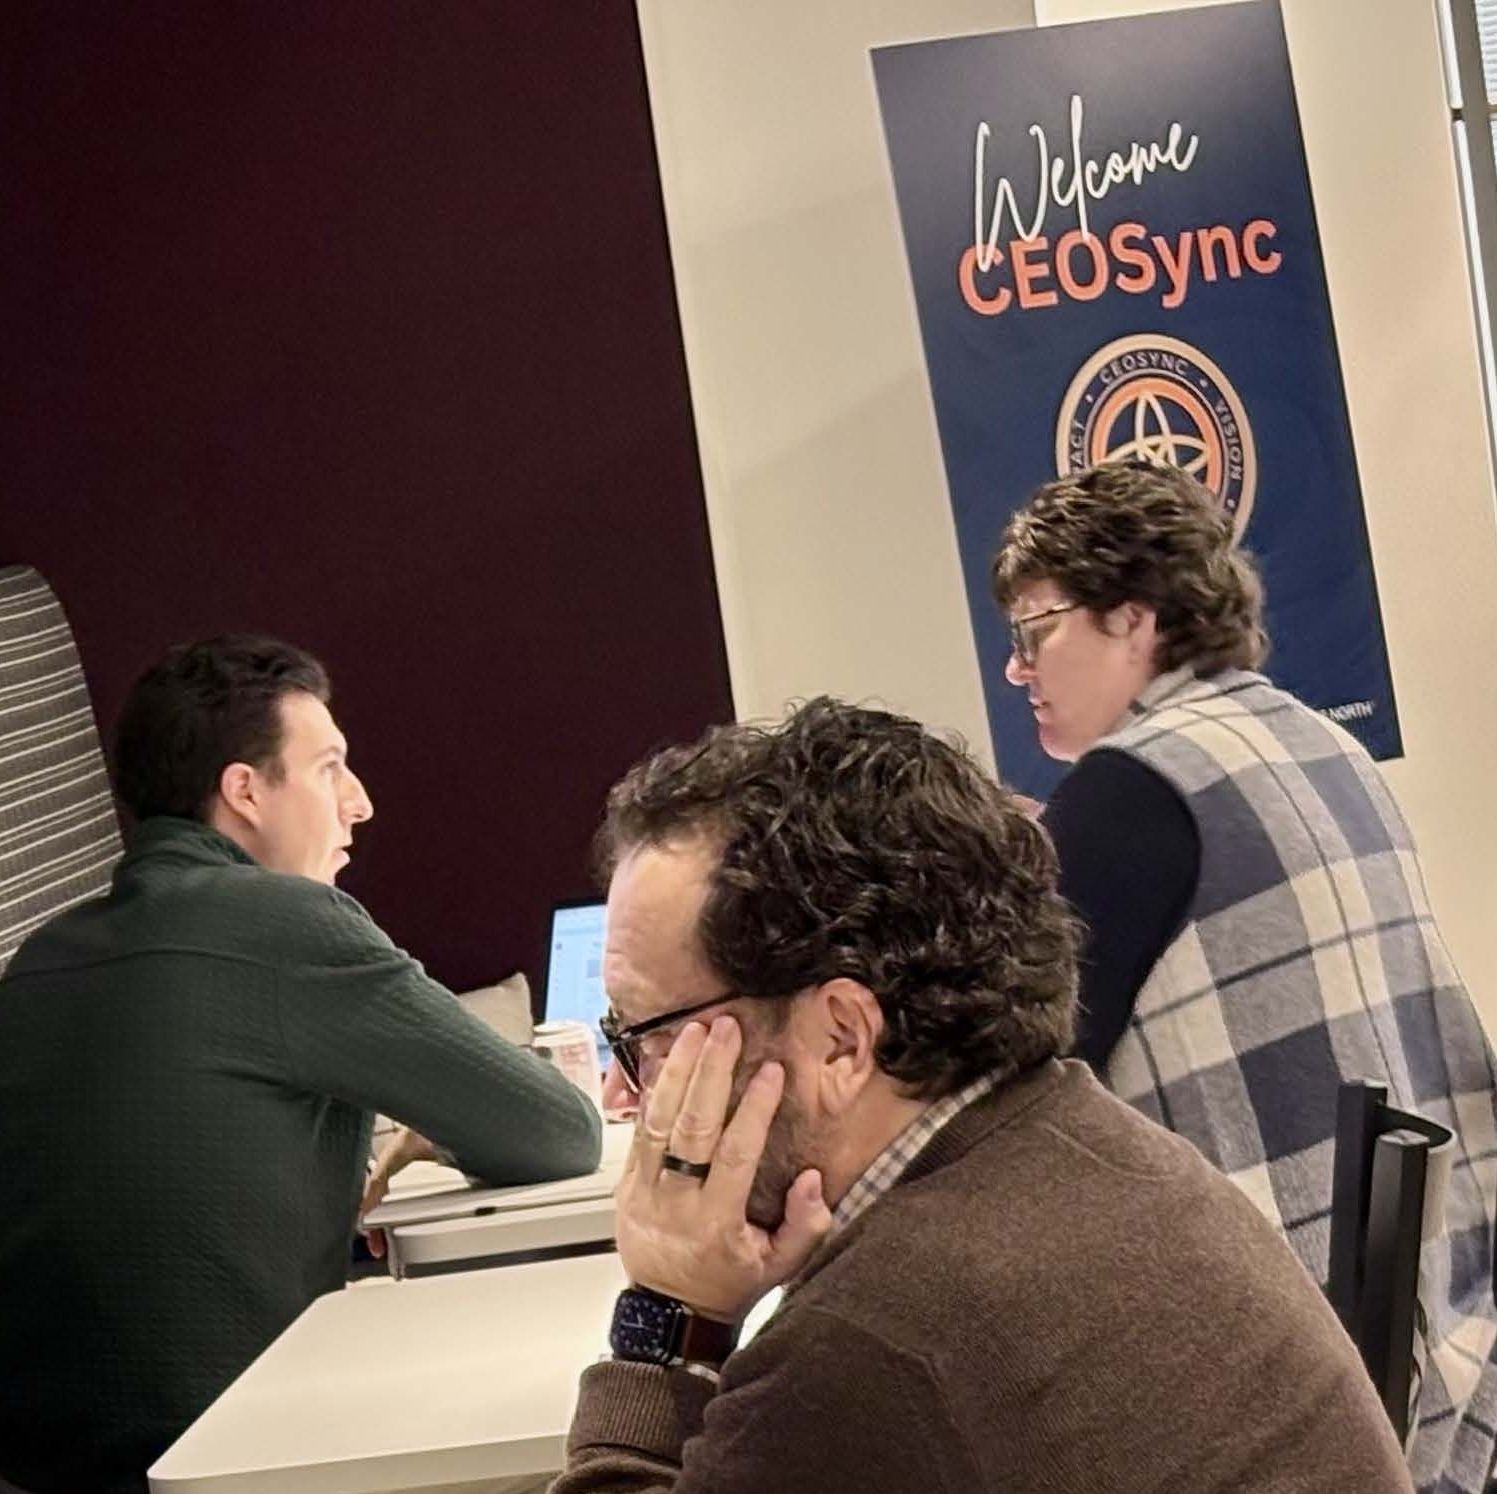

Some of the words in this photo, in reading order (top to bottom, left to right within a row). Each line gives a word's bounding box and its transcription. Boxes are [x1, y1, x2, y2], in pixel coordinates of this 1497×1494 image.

[975, 94, 1199, 273] Welcome
[958, 219, 1283, 316] CEOSync
[1100, 351, 1190, 385] CEOSYNC
[1216, 400, 1244, 481] VISION
